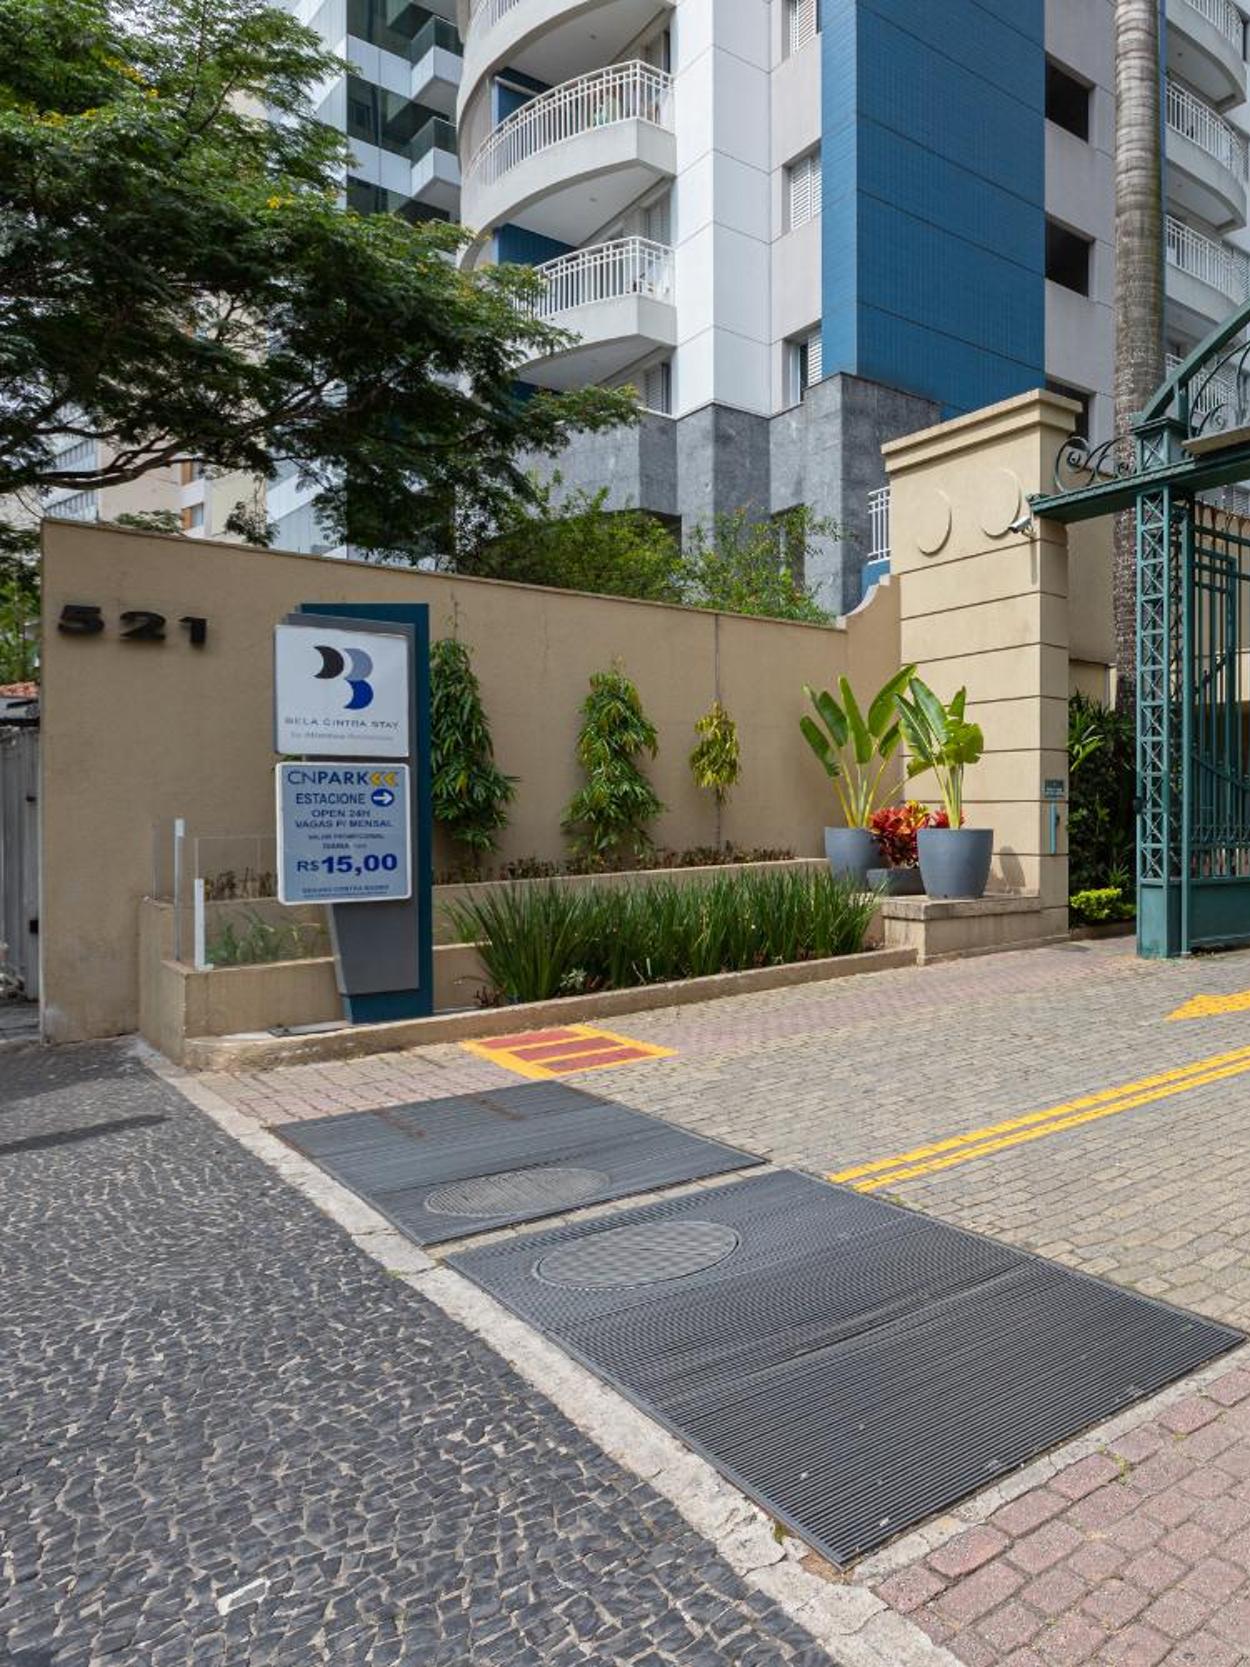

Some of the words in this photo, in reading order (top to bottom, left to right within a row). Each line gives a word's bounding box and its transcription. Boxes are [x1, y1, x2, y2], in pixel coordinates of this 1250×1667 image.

[57, 604, 208, 648] 521
[322, 718, 367, 728] CINTRA
[370, 720, 400, 730] STAY
[296, 792, 366, 805] ESTACIONE
[311, 809, 346, 818] OPEN
[295, 820, 333, 829] VAGAS
[349, 819, 393, 828] MENSAL
